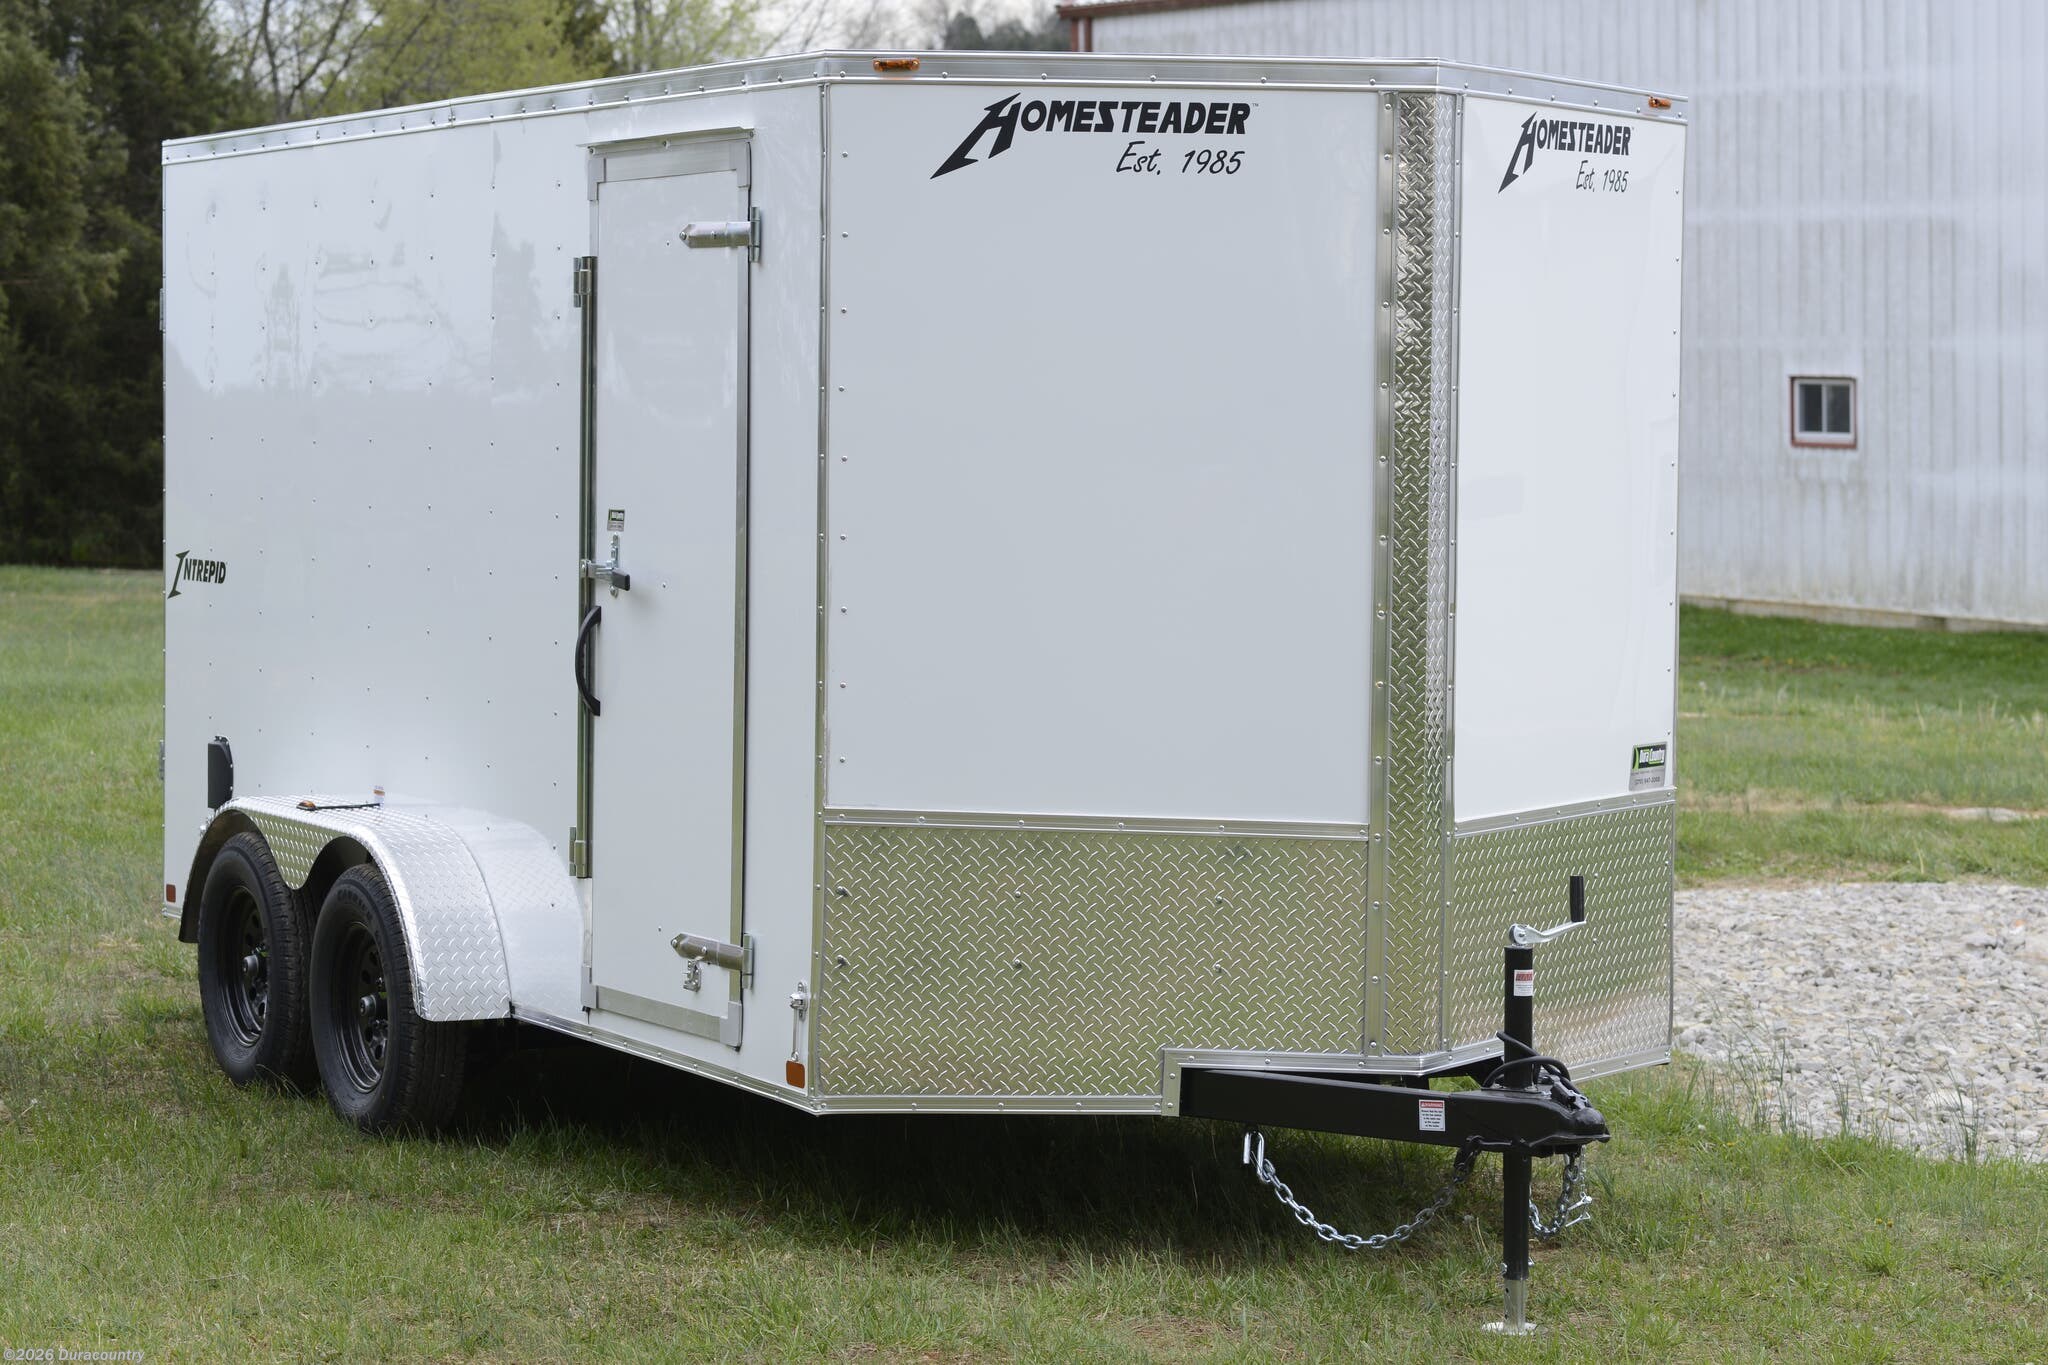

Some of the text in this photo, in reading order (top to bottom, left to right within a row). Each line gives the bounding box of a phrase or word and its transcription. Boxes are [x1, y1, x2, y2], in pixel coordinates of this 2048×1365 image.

[930, 92, 1250, 179] HOMESTEADER
[1116, 140, 1246, 175] Est. 1985
[1498, 111, 1632, 194] HOMESTEADER
[1575, 159, 1630, 193] Est. 1985
[167, 549, 226, 599] INTREPID
